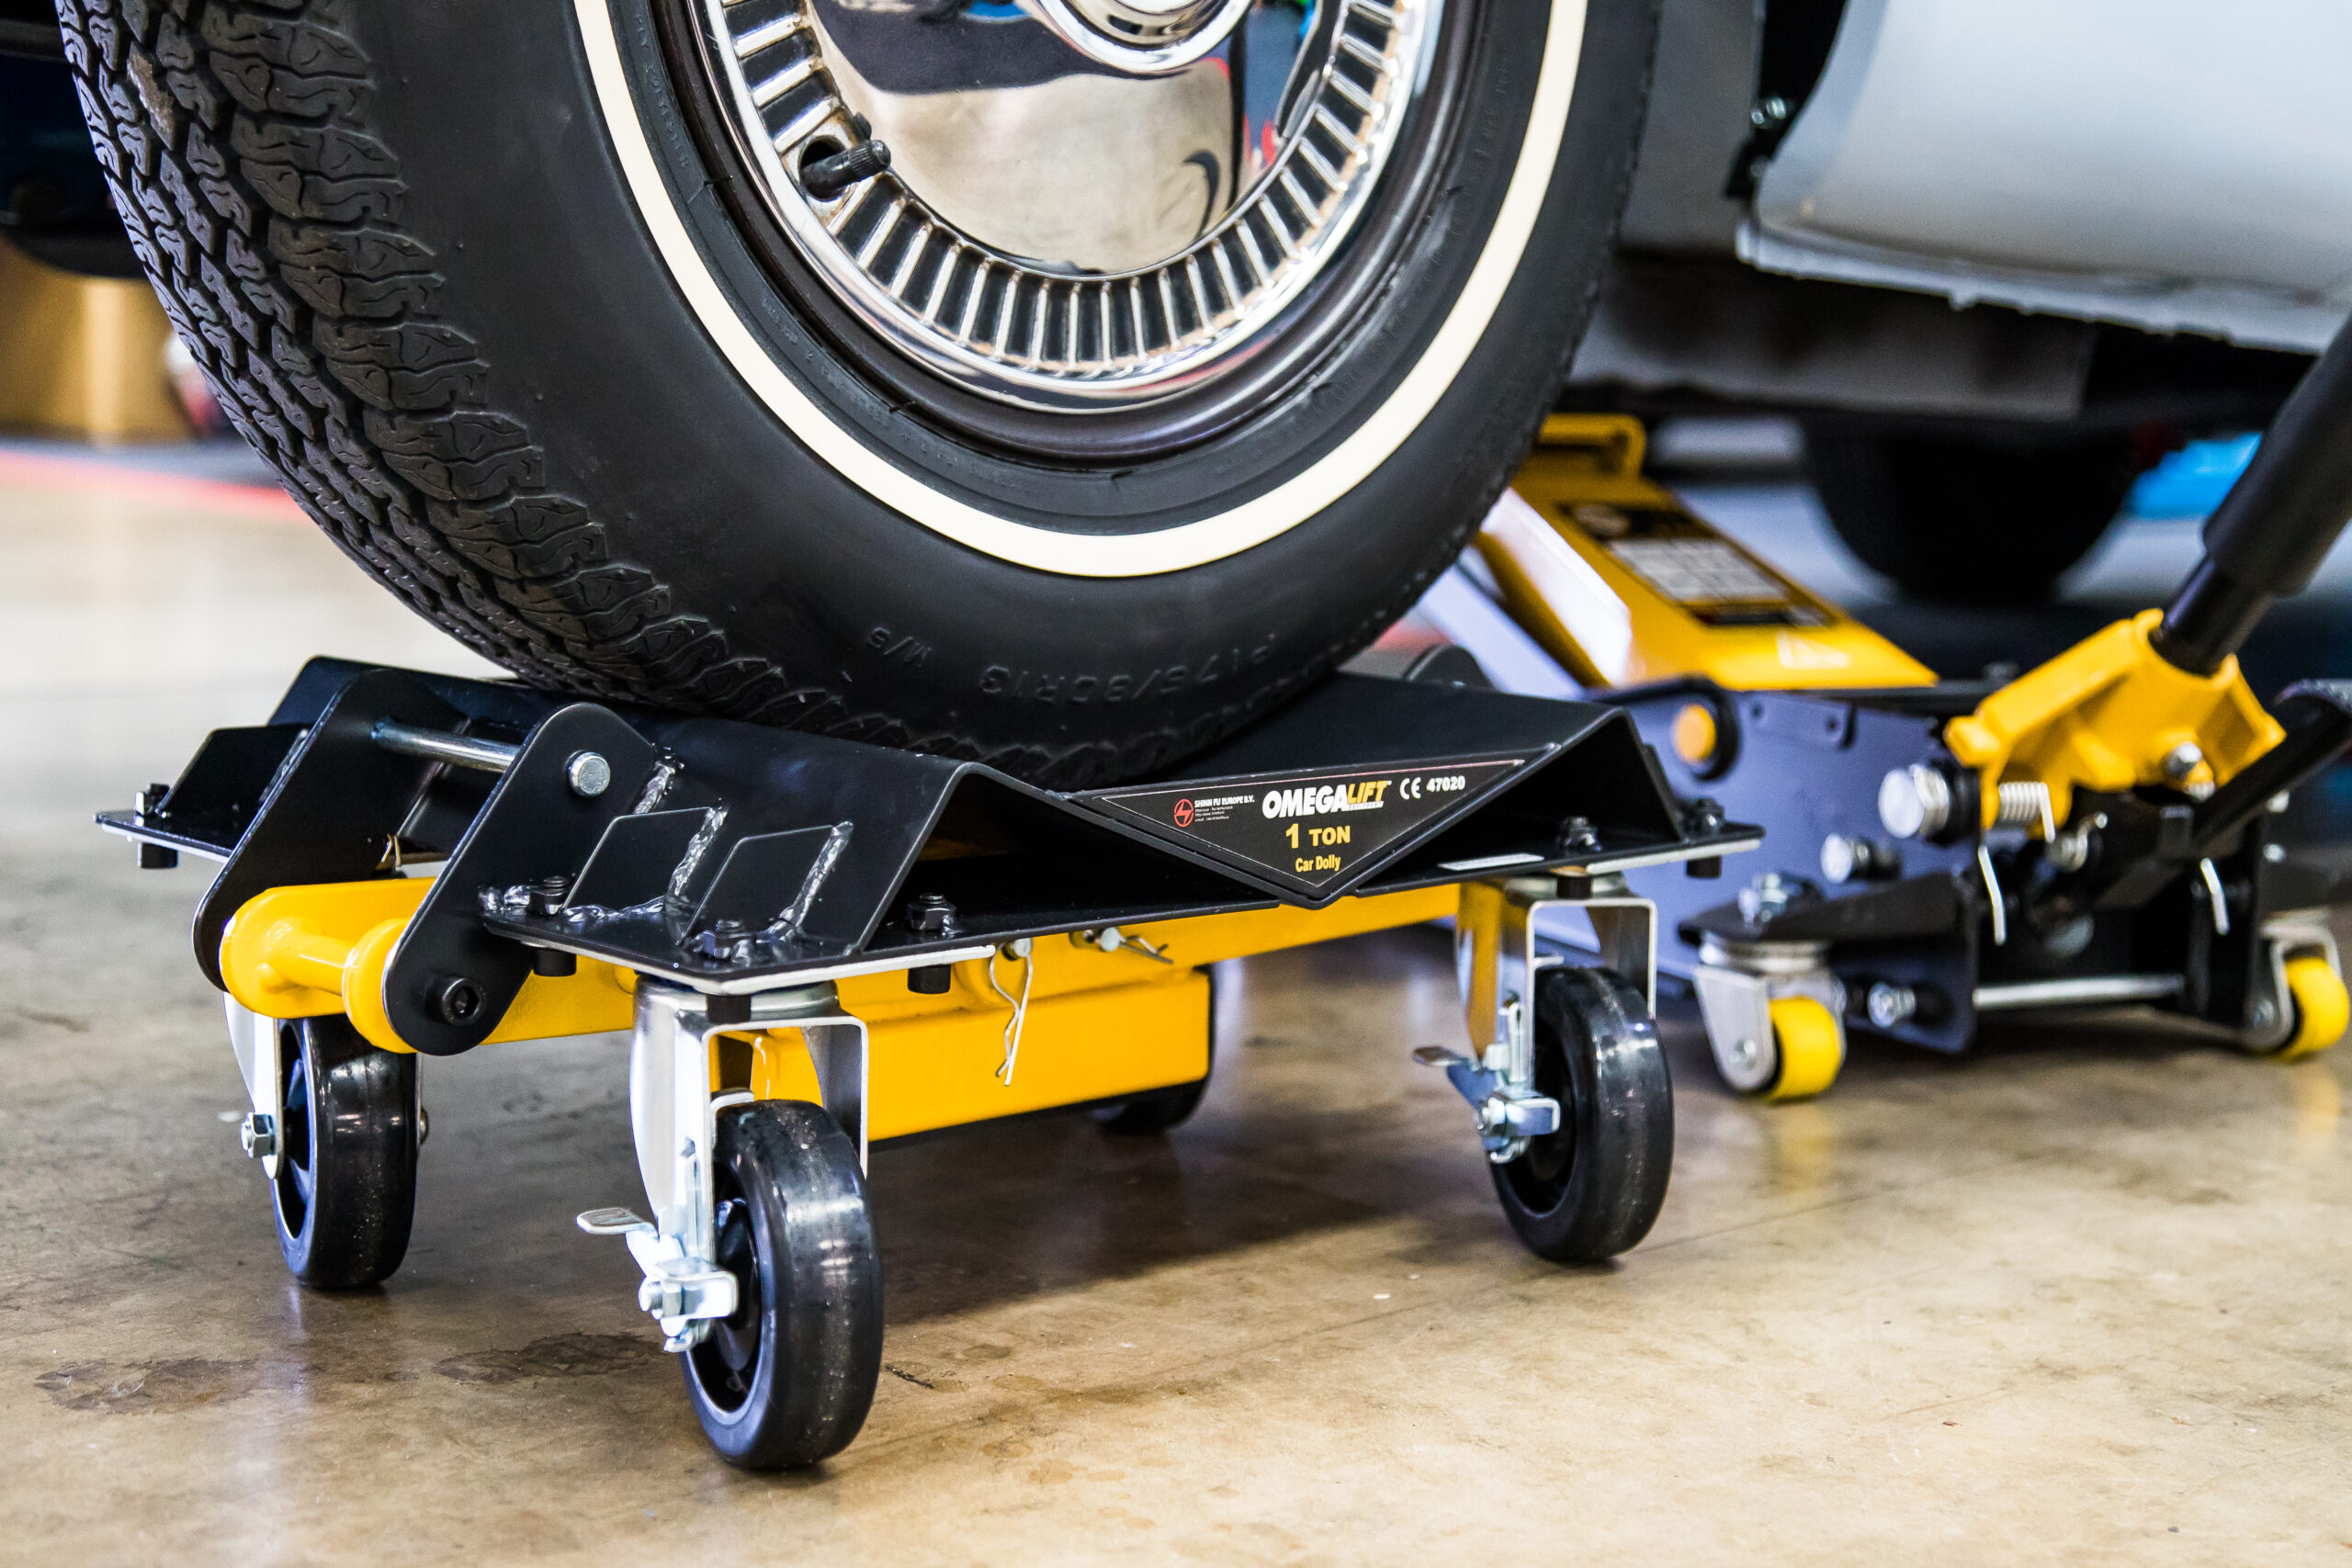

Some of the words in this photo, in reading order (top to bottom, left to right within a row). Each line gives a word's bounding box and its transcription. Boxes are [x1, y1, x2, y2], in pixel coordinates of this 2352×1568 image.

[1426, 775, 1465, 792] 47020
[1194, 799, 1212, 807] SHINN
[1213, 797, 1221, 806] FU
[1221, 795, 1243, 806] EUROPE
[1285, 823, 1299, 849] 1
[1308, 825, 1351, 847] TON
[1295, 857, 1314, 873] Car
[1315, 853, 1341, 872] Dolly
